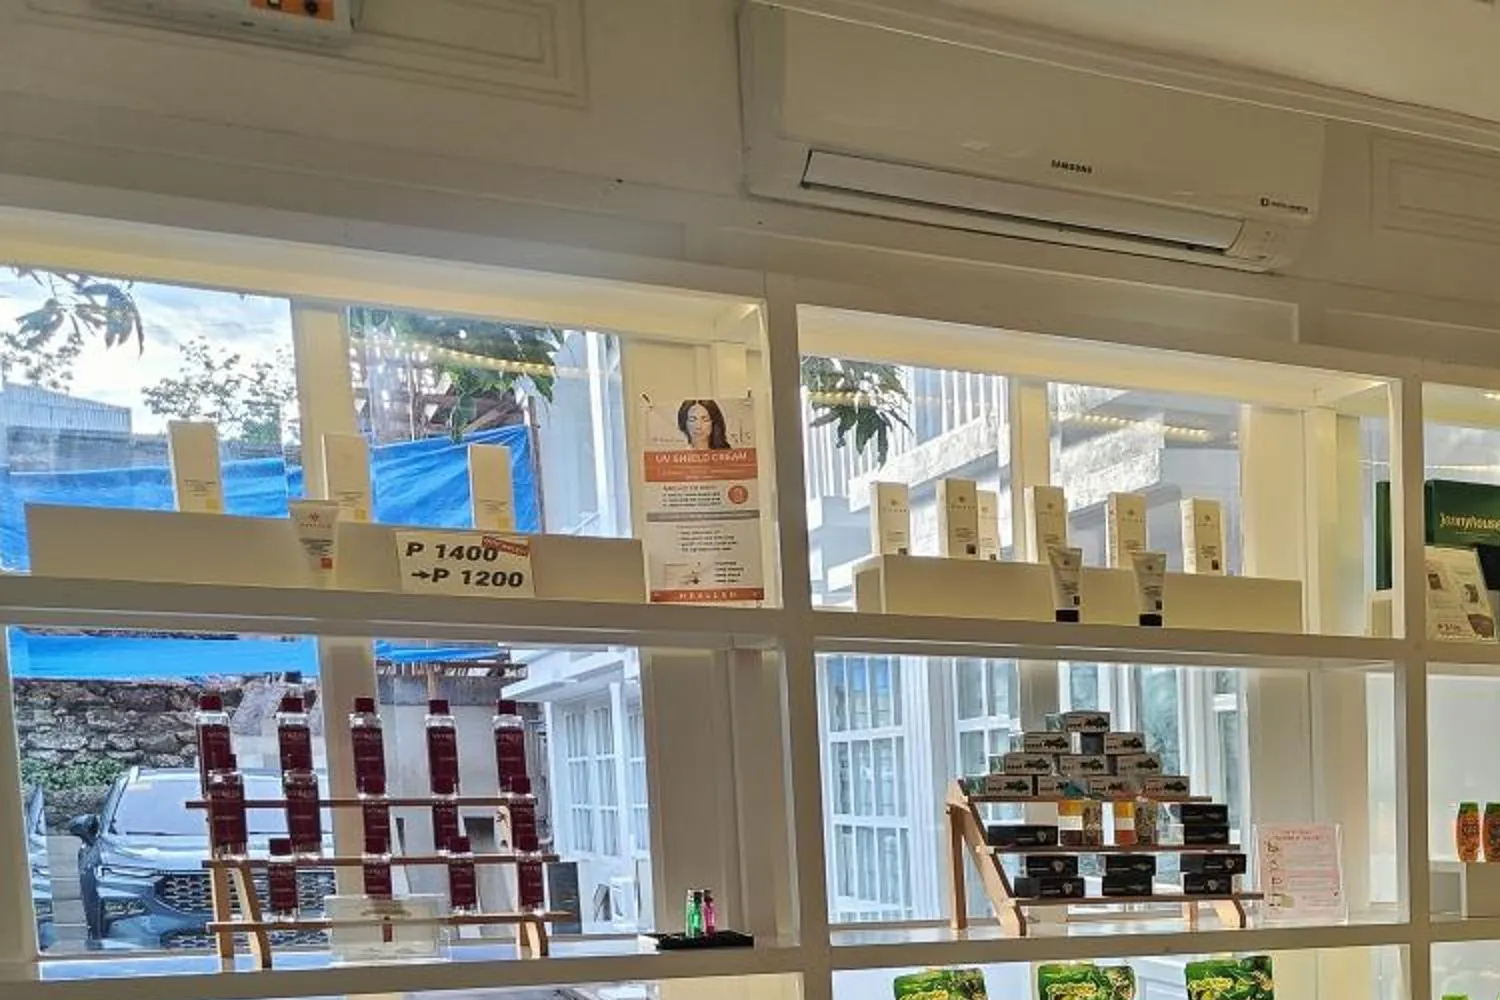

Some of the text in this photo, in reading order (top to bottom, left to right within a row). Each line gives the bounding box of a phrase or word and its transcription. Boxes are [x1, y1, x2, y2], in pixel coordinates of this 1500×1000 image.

[1051, 159, 1093, 174] SAMSUNG
[405, 541, 425, 557] P
[434, 543, 499, 562] 1400
[431, 568, 525, 588] P 1200
